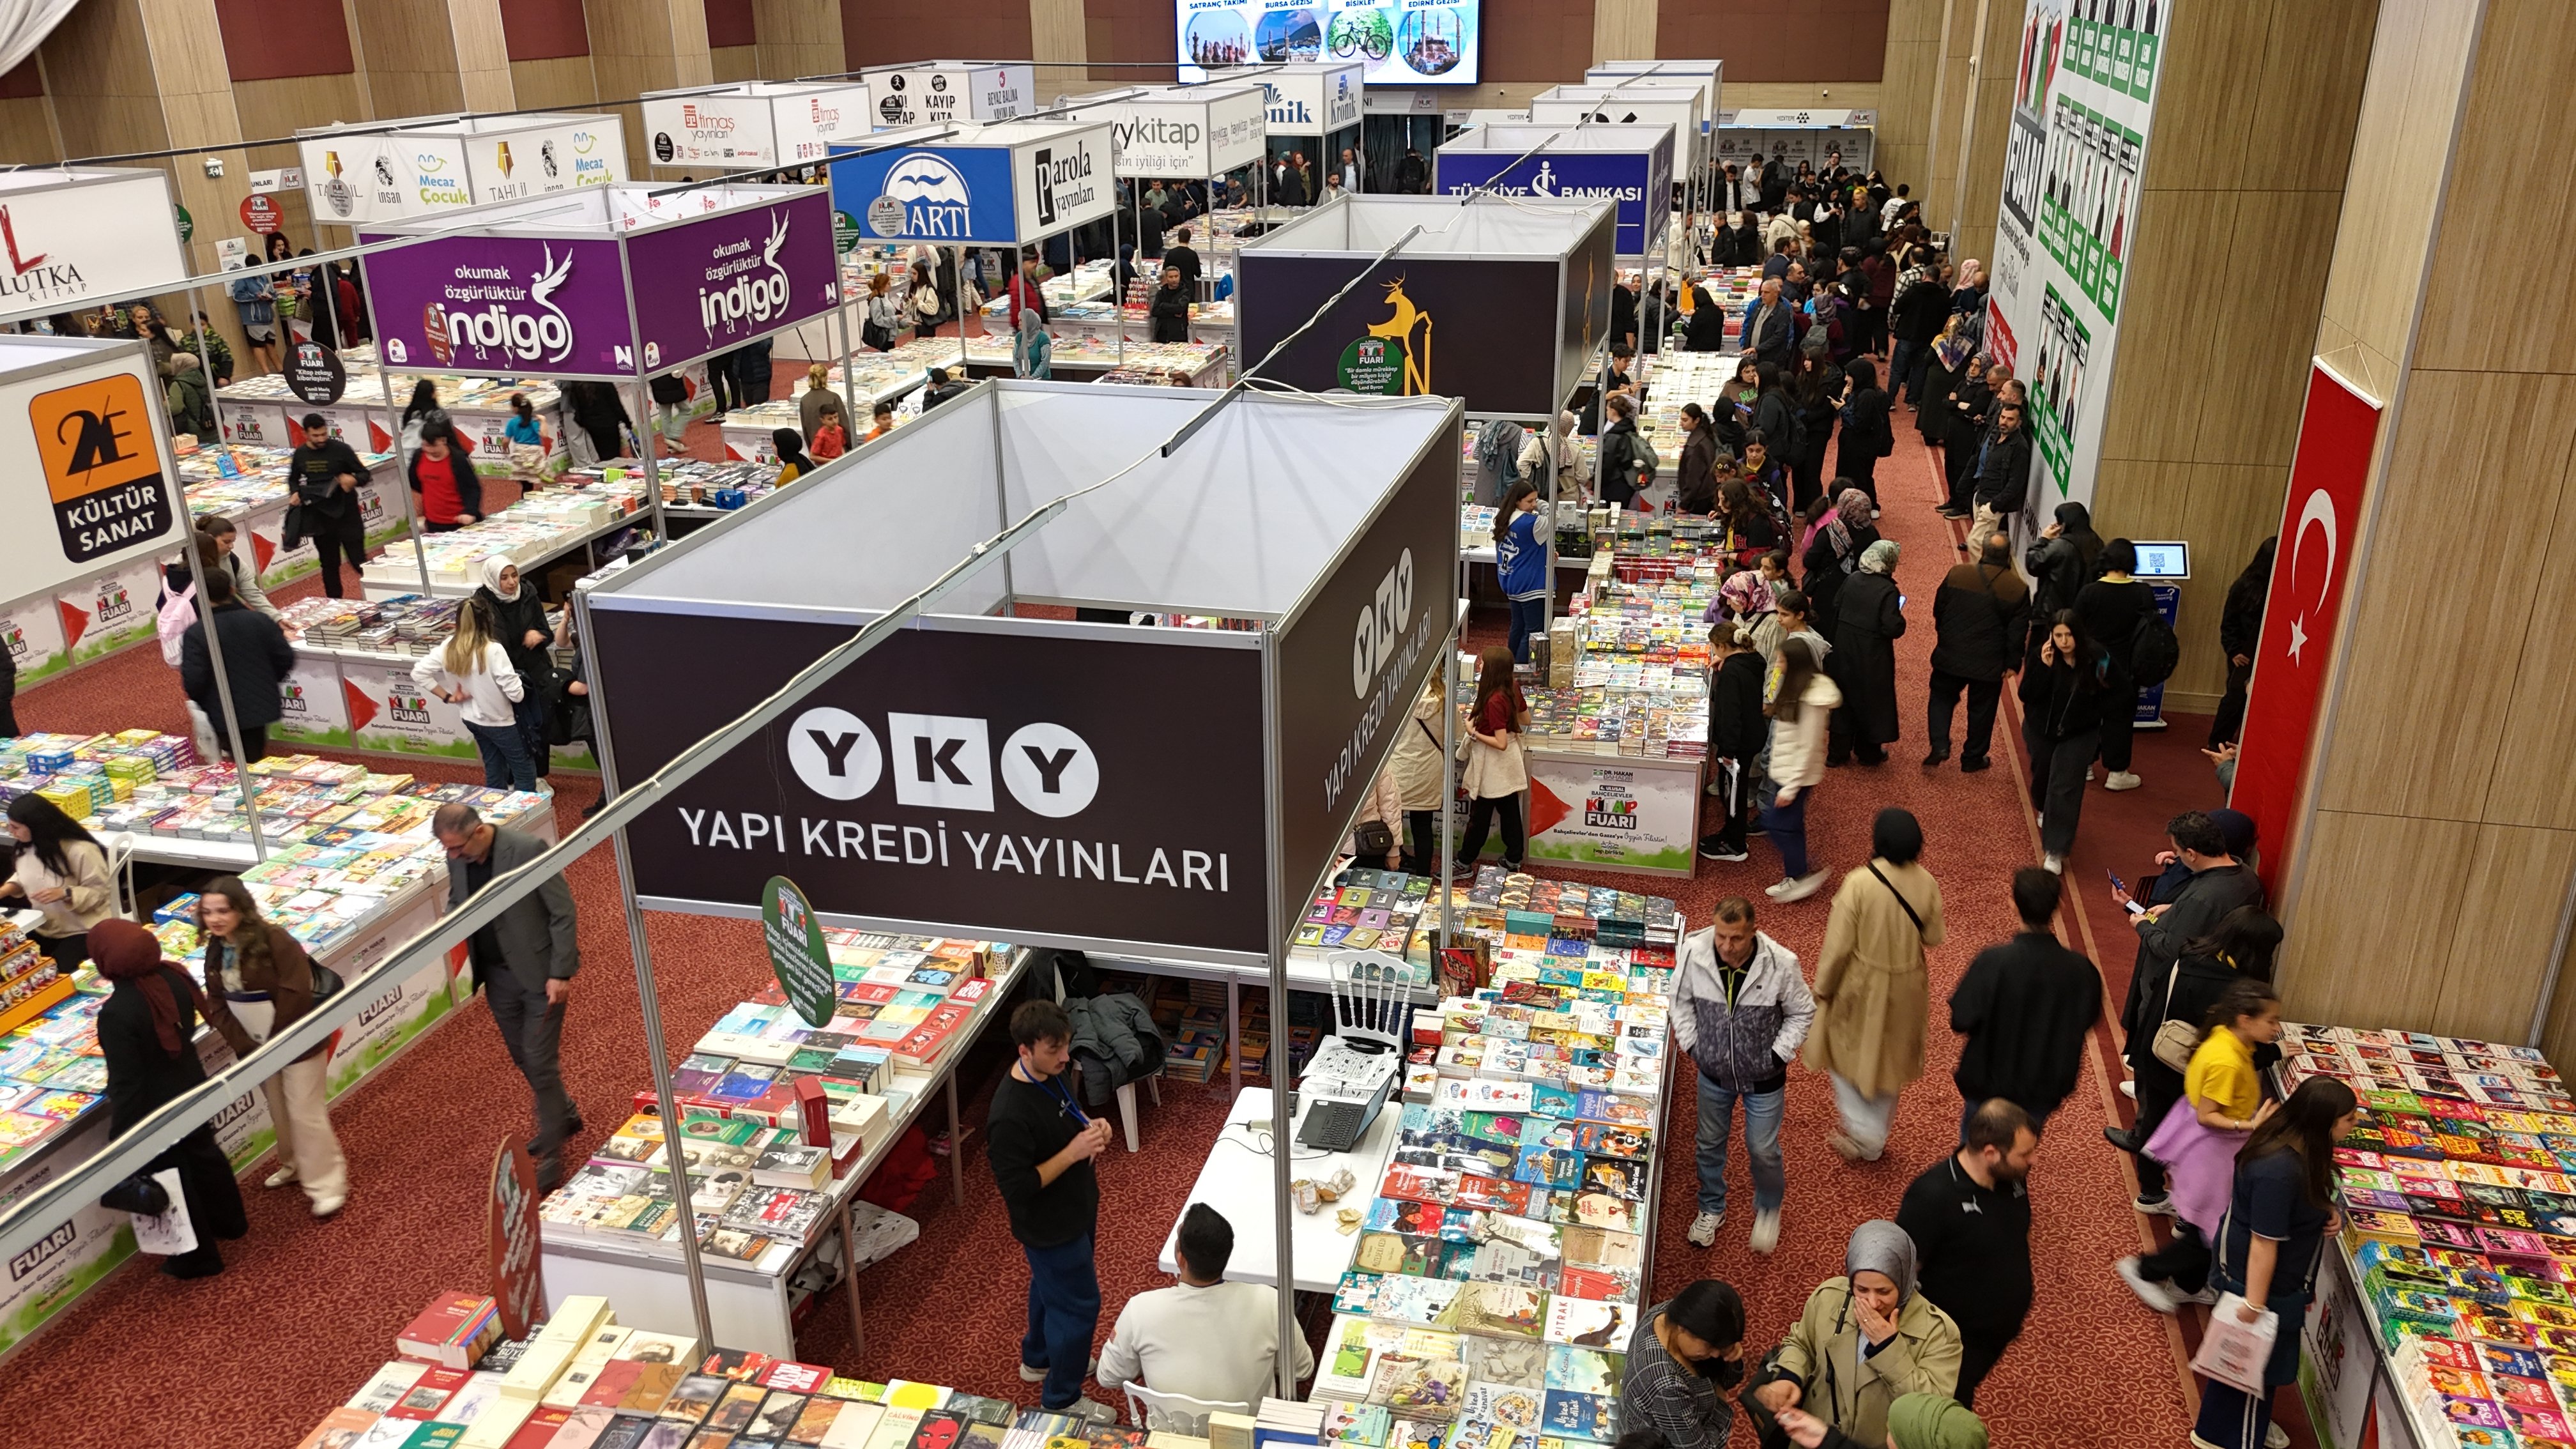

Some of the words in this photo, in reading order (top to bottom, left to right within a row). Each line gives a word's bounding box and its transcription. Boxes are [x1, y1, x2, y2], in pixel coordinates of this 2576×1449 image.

[926, 95, 956, 109] KAYIP
[988, 91, 1002, 106] BEYAZ
[1264, 100, 1313, 123] onik
[1330, 95, 1356, 126] Kronik
[699, 114, 735, 132] timaş
[576, 158, 604, 172] Mecaz
[419, 175, 456, 188] Mecaz
[1037, 140, 1092, 218] Parola
[419, 188, 469, 206] Çocuk
[1055, 183, 1095, 220] yayınları
[1561, 187, 1642, 201] BANKASI
[901, 206, 972, 237] ARTI
[712, 237, 751, 259] okumak
[455, 264, 510, 280] okumak
[705, 254, 762, 282] özgürlüktür
[27, 282, 87, 302] KİTAP
[445, 284, 526, 303] özgürlüktür
[700, 272, 785, 328] indigo
[436, 302, 567, 362] indigo
[301, 359, 325, 368] FUARI
[1359, 356, 1384, 365] FUARI
[239, 431, 263, 440] FUARI
[66, 485, 158, 529] KÜLTÜR
[79, 510, 156, 552] SANAT
[100, 602, 130, 622] FUARI
[281, 698, 306, 711] UARI
[1324, 739, 1353, 813] YAPI
[1354, 674, 1385, 767] KREDİ
[1386, 606, 1431, 707] YAYINLARI
[392, 709, 429, 723] FUARI
[802, 724, 1082, 799] YKY
[1586, 796, 1638, 815] KİTAP
[1586, 813, 1634, 829] FUARI
[678, 806, 786, 854] YAPI
[800, 816, 947, 869] KREDİ
[962, 831, 1230, 892] YAYINLARI
[781, 917, 808, 947] FUARI
[767, 933, 785, 954] denizin
[794, 967, 803, 977] bir
[786, 973, 802, 991] Franz
[801, 986, 816, 1004] Kafka
[360, 986, 402, 1025] FUARI
[12, 1222, 75, 1278] FUARI
[1570, 1276, 1583, 1298] Sarayda
[1554, 1301, 1568, 1337] PITRAK
[1469, 1392, 1479, 1406] kedi
[1480, 1386, 1488, 1413] canavar
[1558, 1400, 1568, 1416] kedi
[1564, 1418, 1578, 1429] Bir
